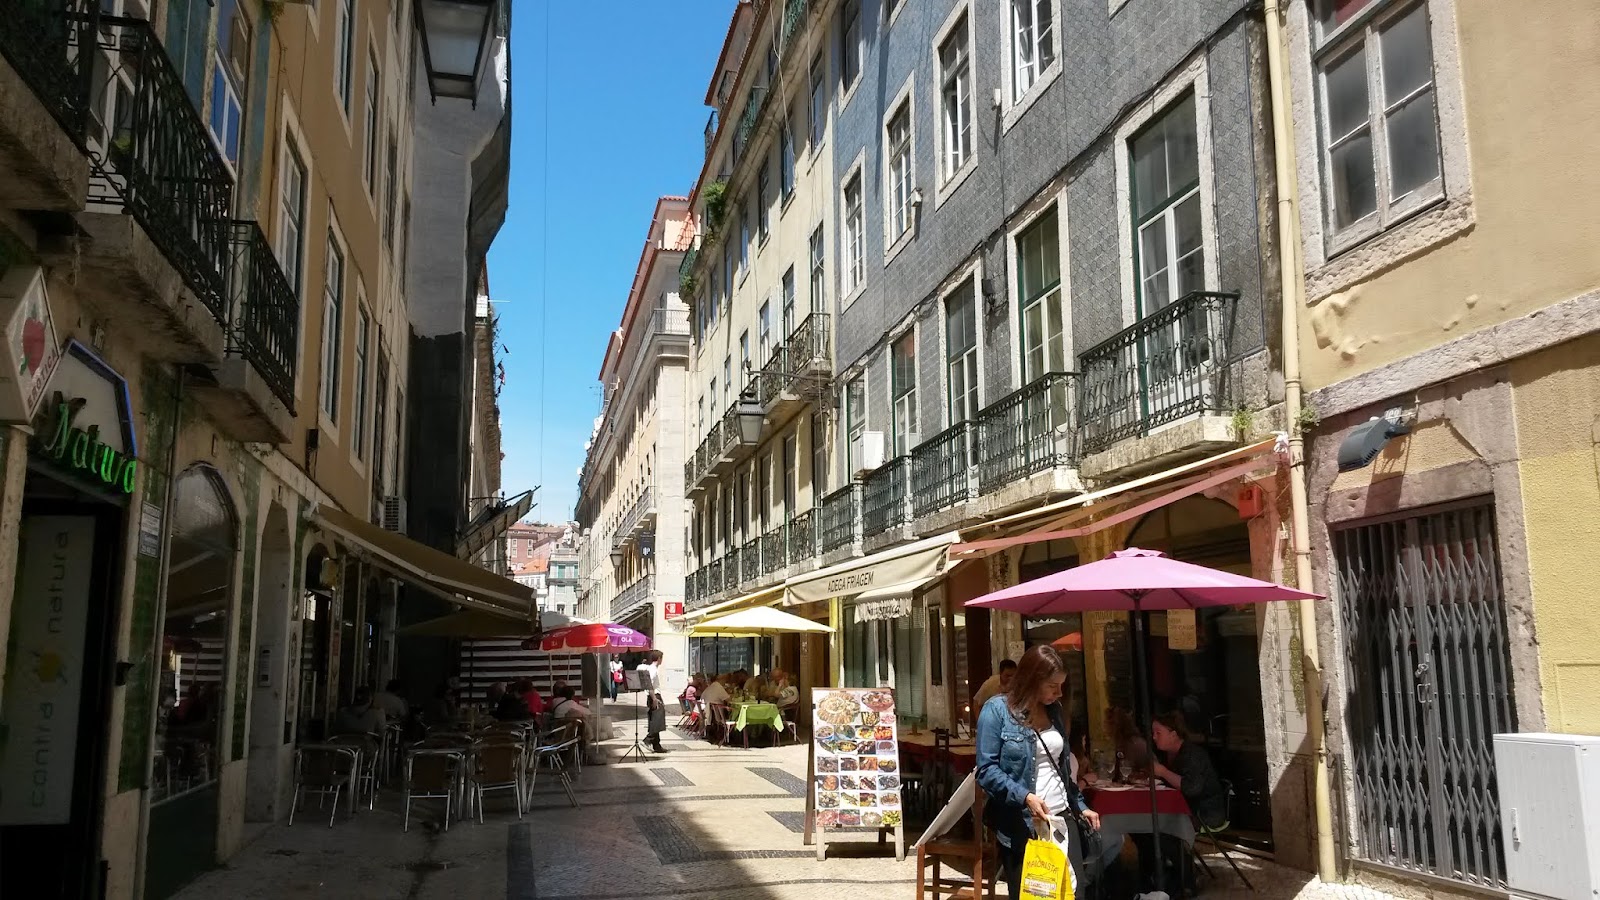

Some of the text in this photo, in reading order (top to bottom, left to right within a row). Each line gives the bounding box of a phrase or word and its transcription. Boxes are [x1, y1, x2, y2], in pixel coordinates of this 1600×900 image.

[27, 347, 58, 408] EROTICA
[43, 393, 137, 494] Natura
[827, 570, 875, 593] ADEGA FRIAGEM
[29, 530, 69, 808] contra natura
